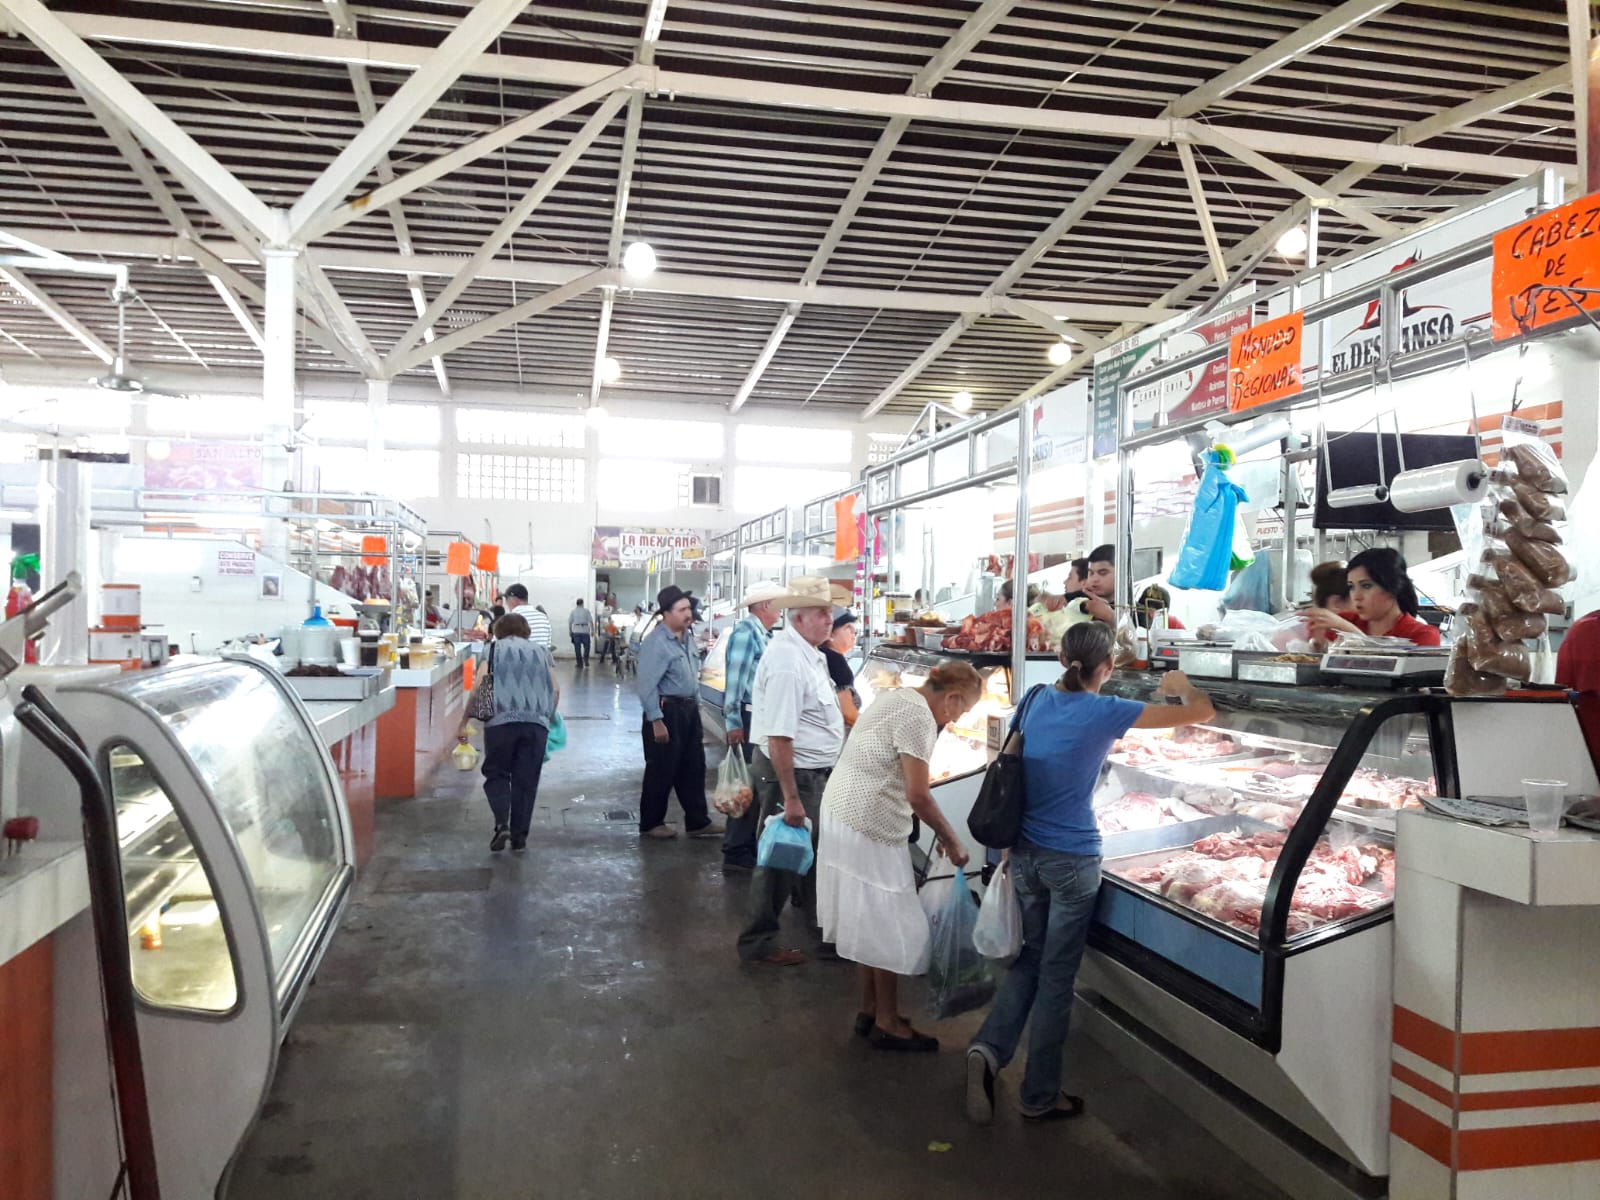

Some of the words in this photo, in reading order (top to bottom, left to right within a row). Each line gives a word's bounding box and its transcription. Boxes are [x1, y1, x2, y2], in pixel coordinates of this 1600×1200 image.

[1511, 207, 1600, 259] CABEZ
[1543, 252, 1567, 278] DE
[1237, 326, 1296, 364] MENUDO
[1332, 352, 1350, 374] EL
[1350, 313, 1454, 370] DESANSO
[1231, 364, 1297, 410] REGIONAL
[622, 535, 636, 547] LA
[639, 535, 698, 548] MEXICANA
[1256, 526, 1279, 535] PUESTO
